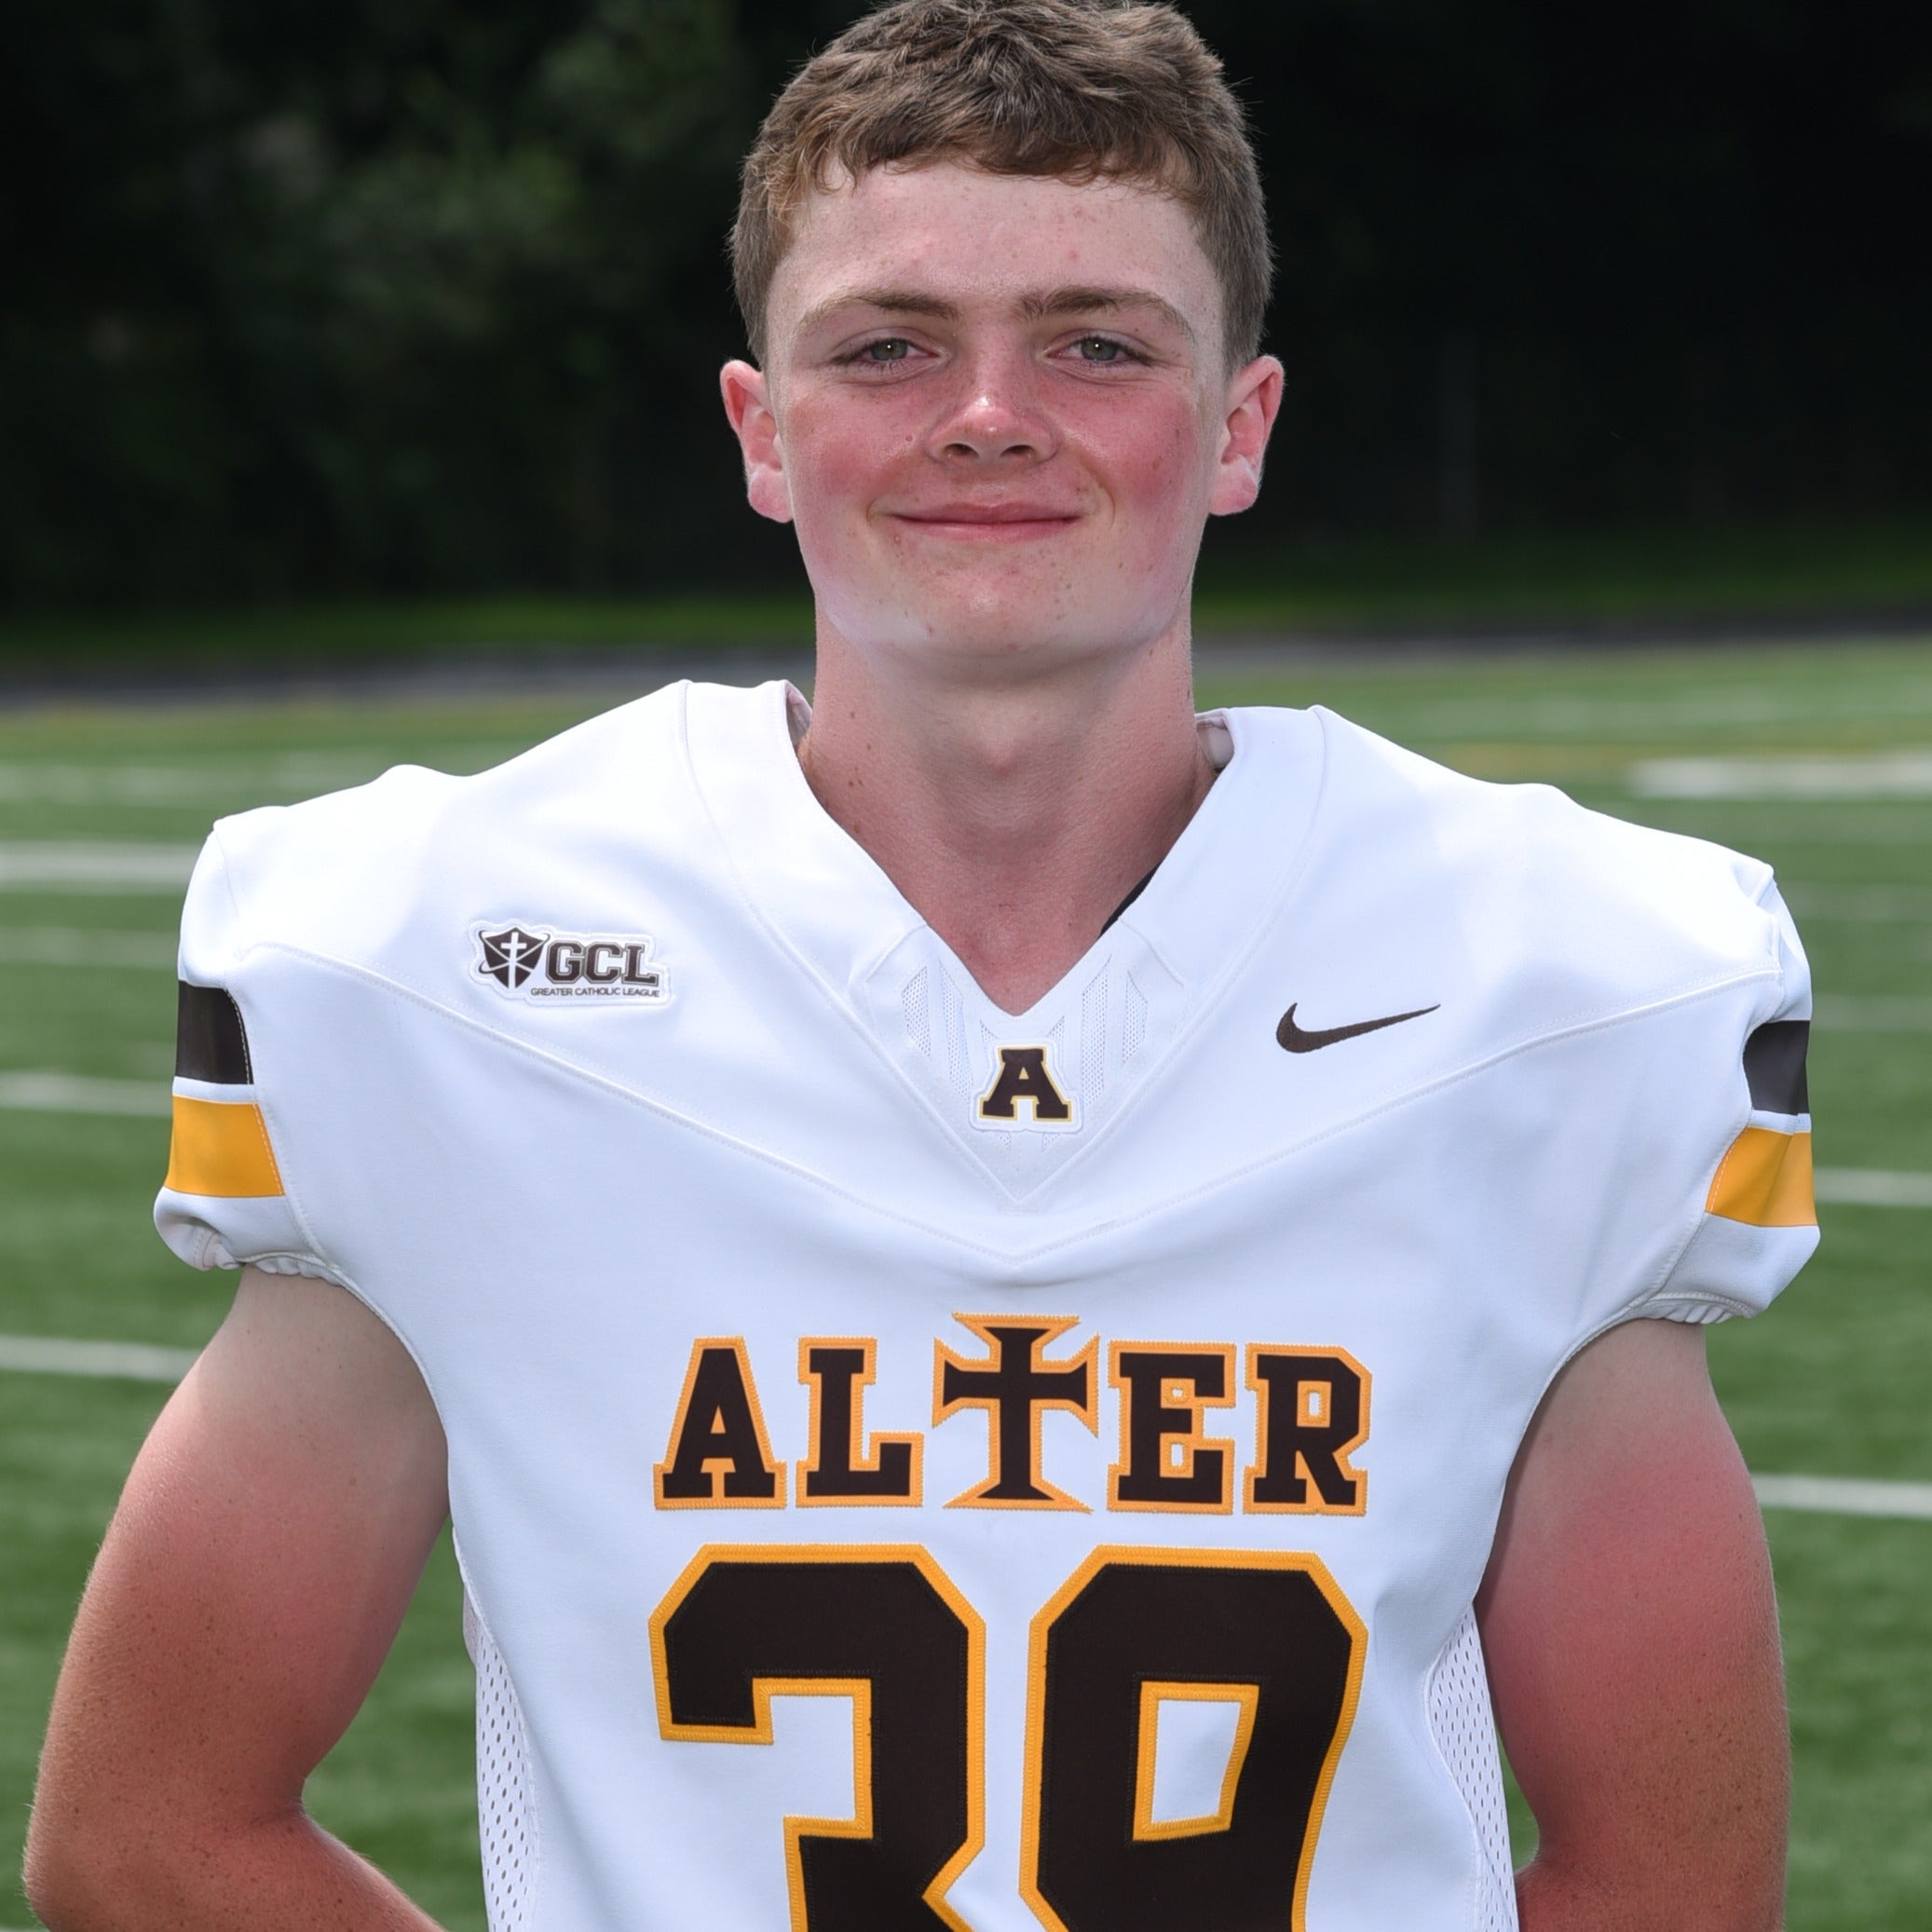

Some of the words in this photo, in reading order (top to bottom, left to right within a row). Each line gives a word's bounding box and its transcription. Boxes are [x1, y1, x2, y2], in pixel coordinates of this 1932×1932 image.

[530, 986, 573, 997] GREATER
[575, 987, 621, 997] CATHOLIC
[622, 987, 660, 998] LEAGUE
[546, 940, 660, 986] GCL
[979, 1045, 1072, 1122] A
[653, 1312, 1373, 1516] ALTER
